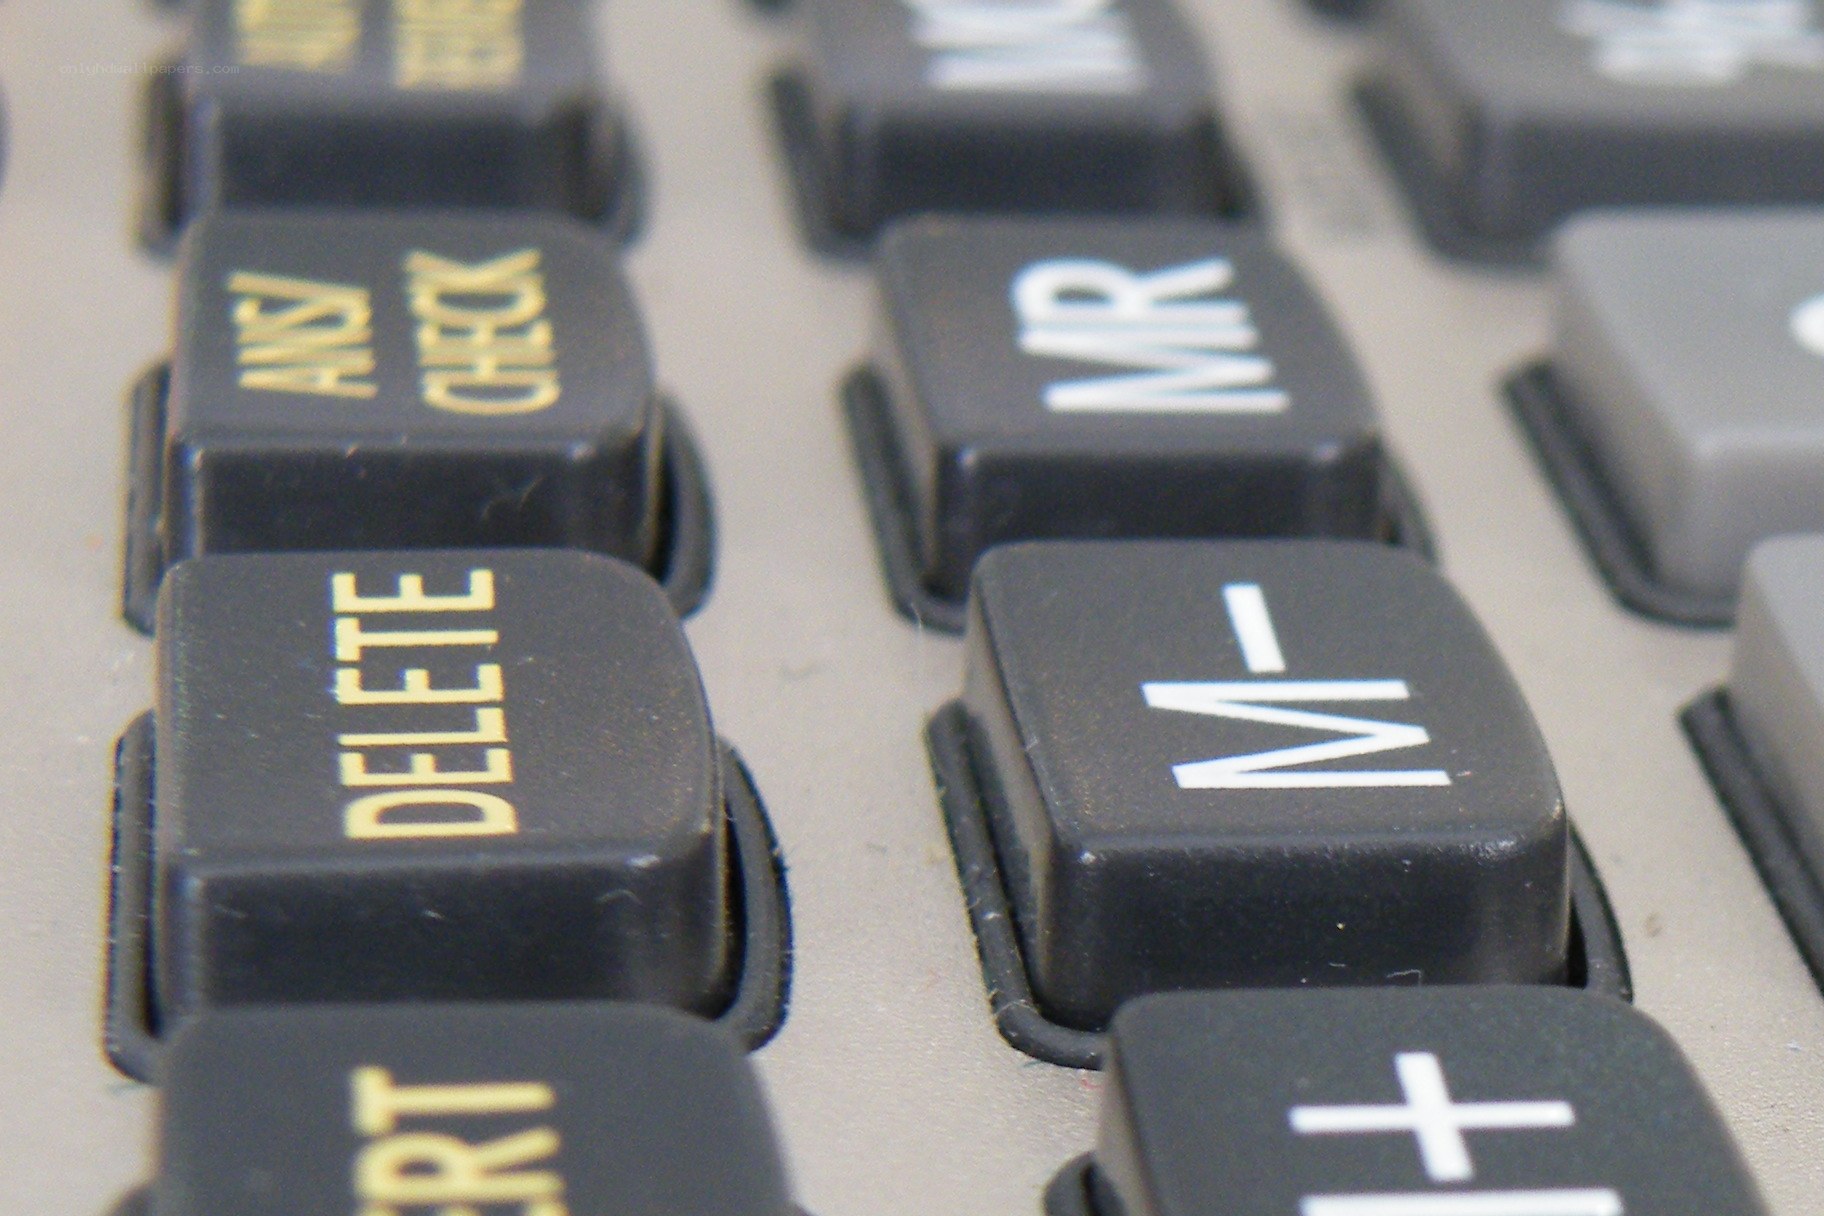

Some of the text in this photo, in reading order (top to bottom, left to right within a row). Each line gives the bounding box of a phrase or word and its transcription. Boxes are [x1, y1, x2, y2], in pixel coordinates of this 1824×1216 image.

[405, 247, 561, 416] CHECK
[1012, 257, 1291, 412] MR
[332, 568, 519, 839] DELETE
[1141, 582, 1452, 789] M-
